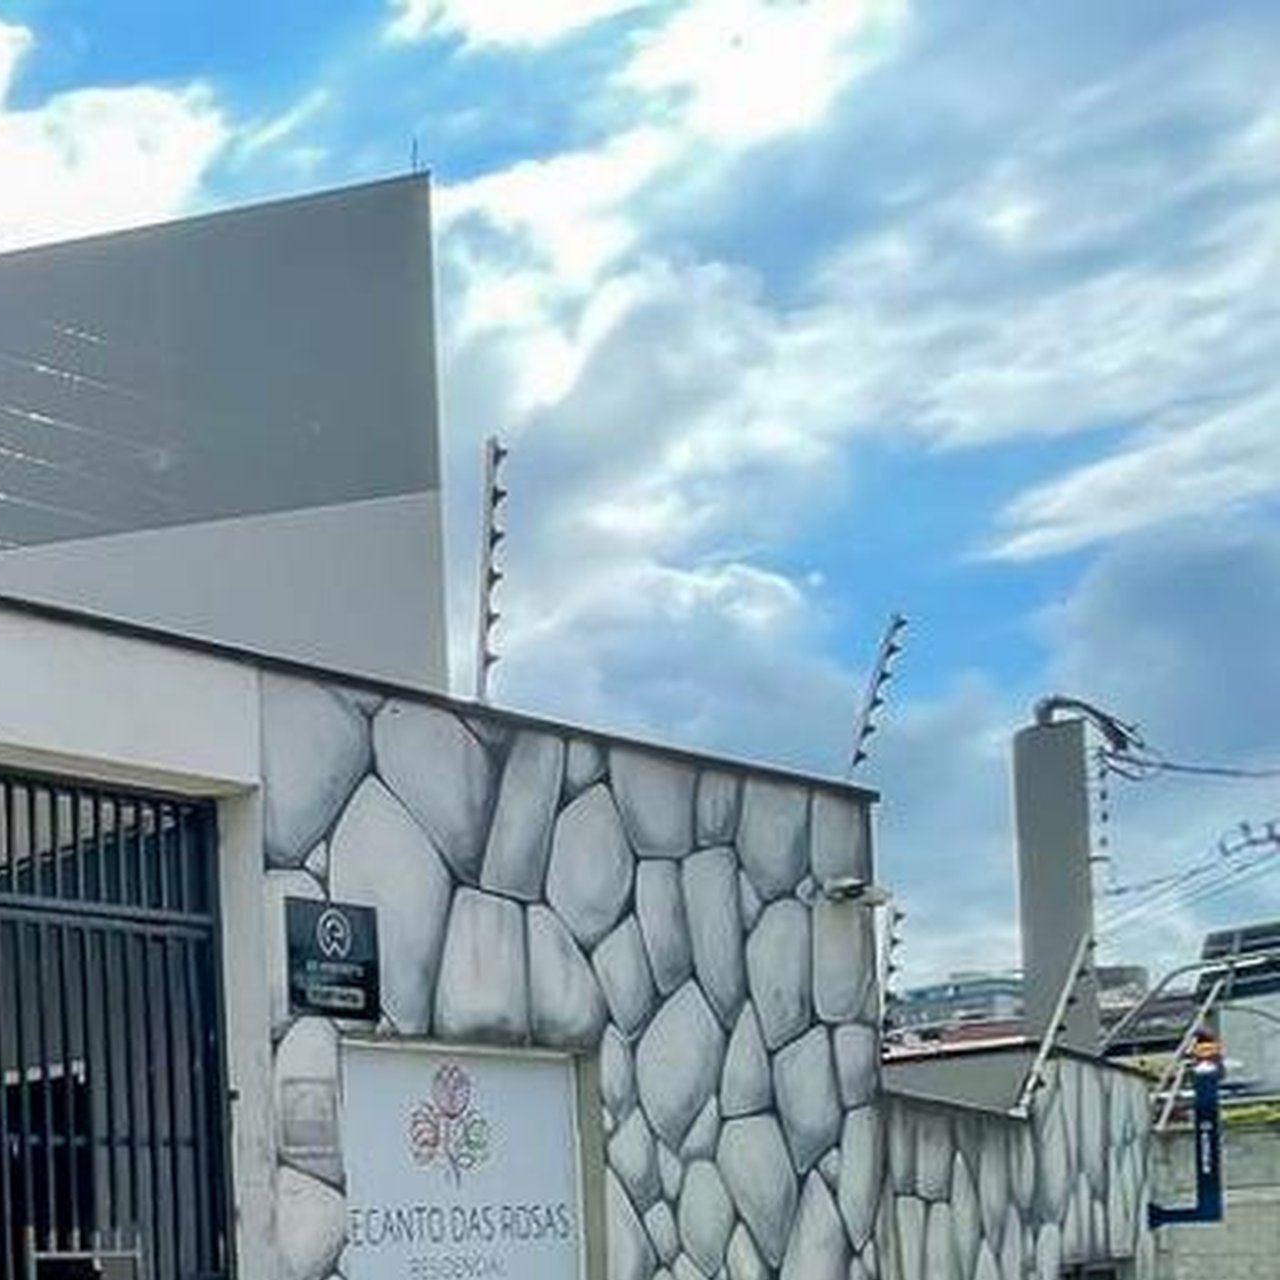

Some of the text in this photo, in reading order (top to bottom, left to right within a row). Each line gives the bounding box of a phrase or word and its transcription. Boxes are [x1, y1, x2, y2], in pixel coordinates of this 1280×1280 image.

[348, 1203, 572, 1247] ECANTO DAS ROSAS
